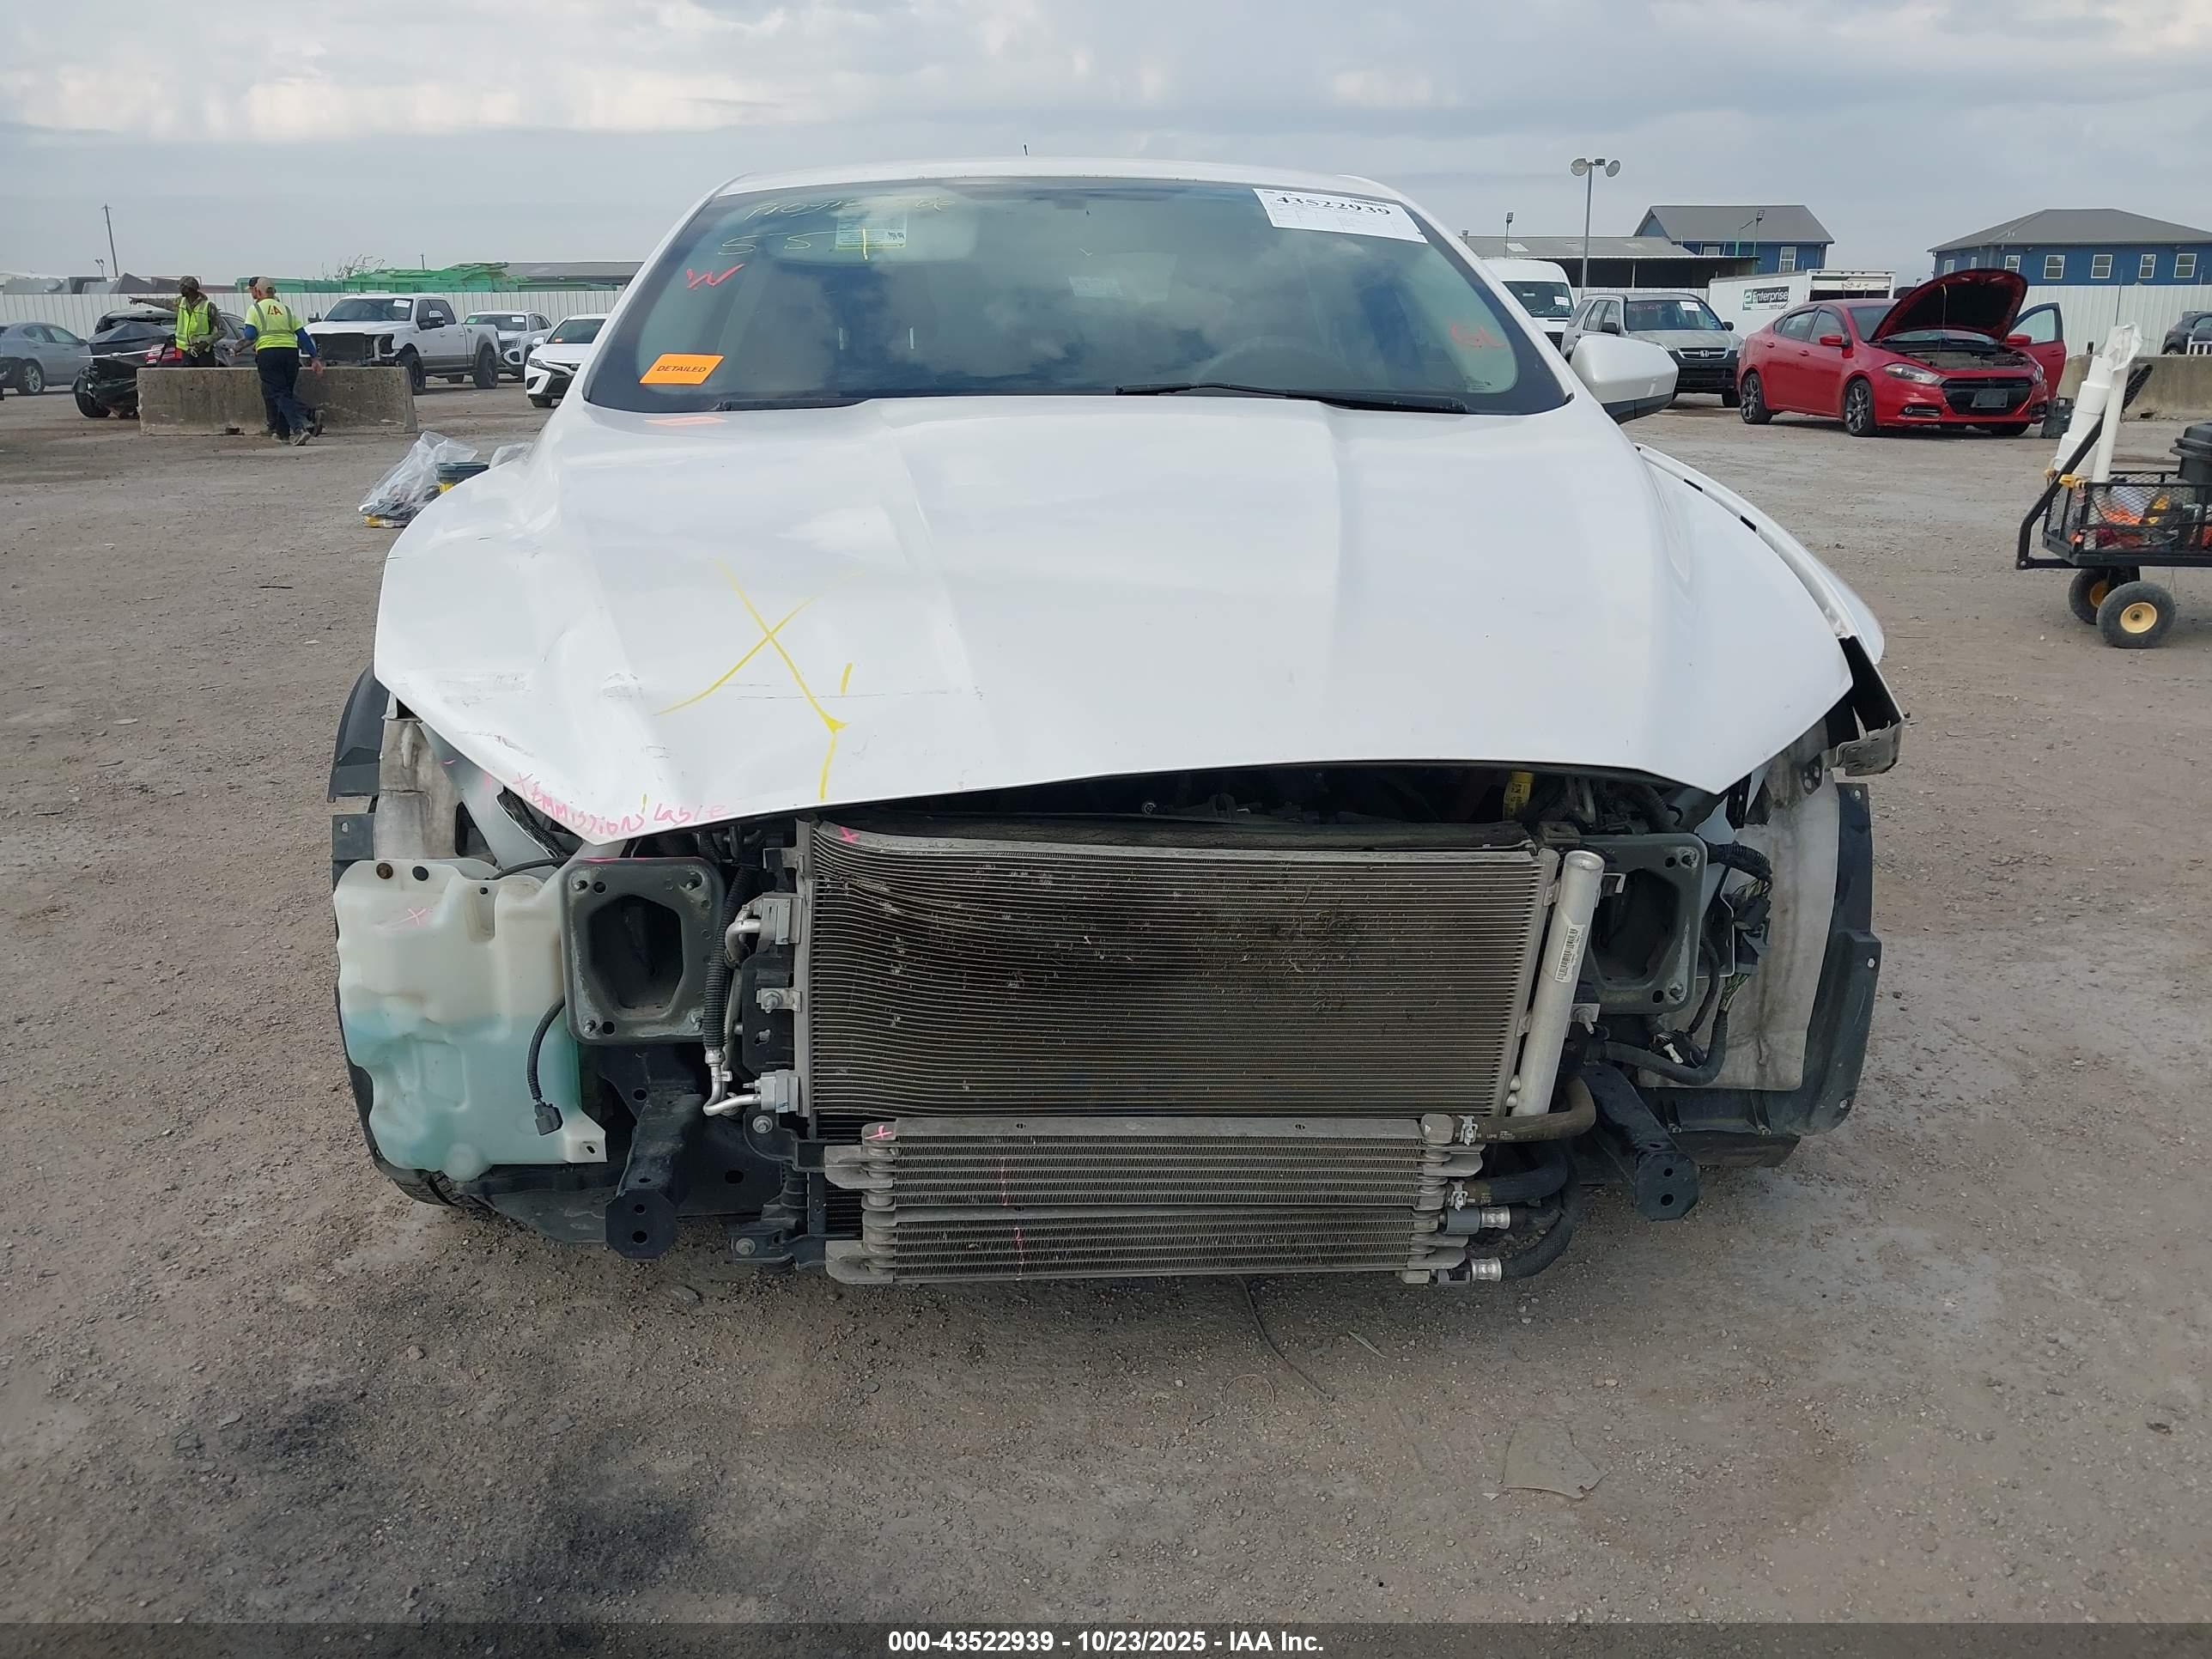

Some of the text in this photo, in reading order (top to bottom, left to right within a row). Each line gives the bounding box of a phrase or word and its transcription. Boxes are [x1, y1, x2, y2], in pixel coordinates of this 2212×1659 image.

[1276, 197, 1392, 216] 43522939
[1753, 289, 1789, 302] Enterprise
[656, 365, 708, 374] DETAILED
